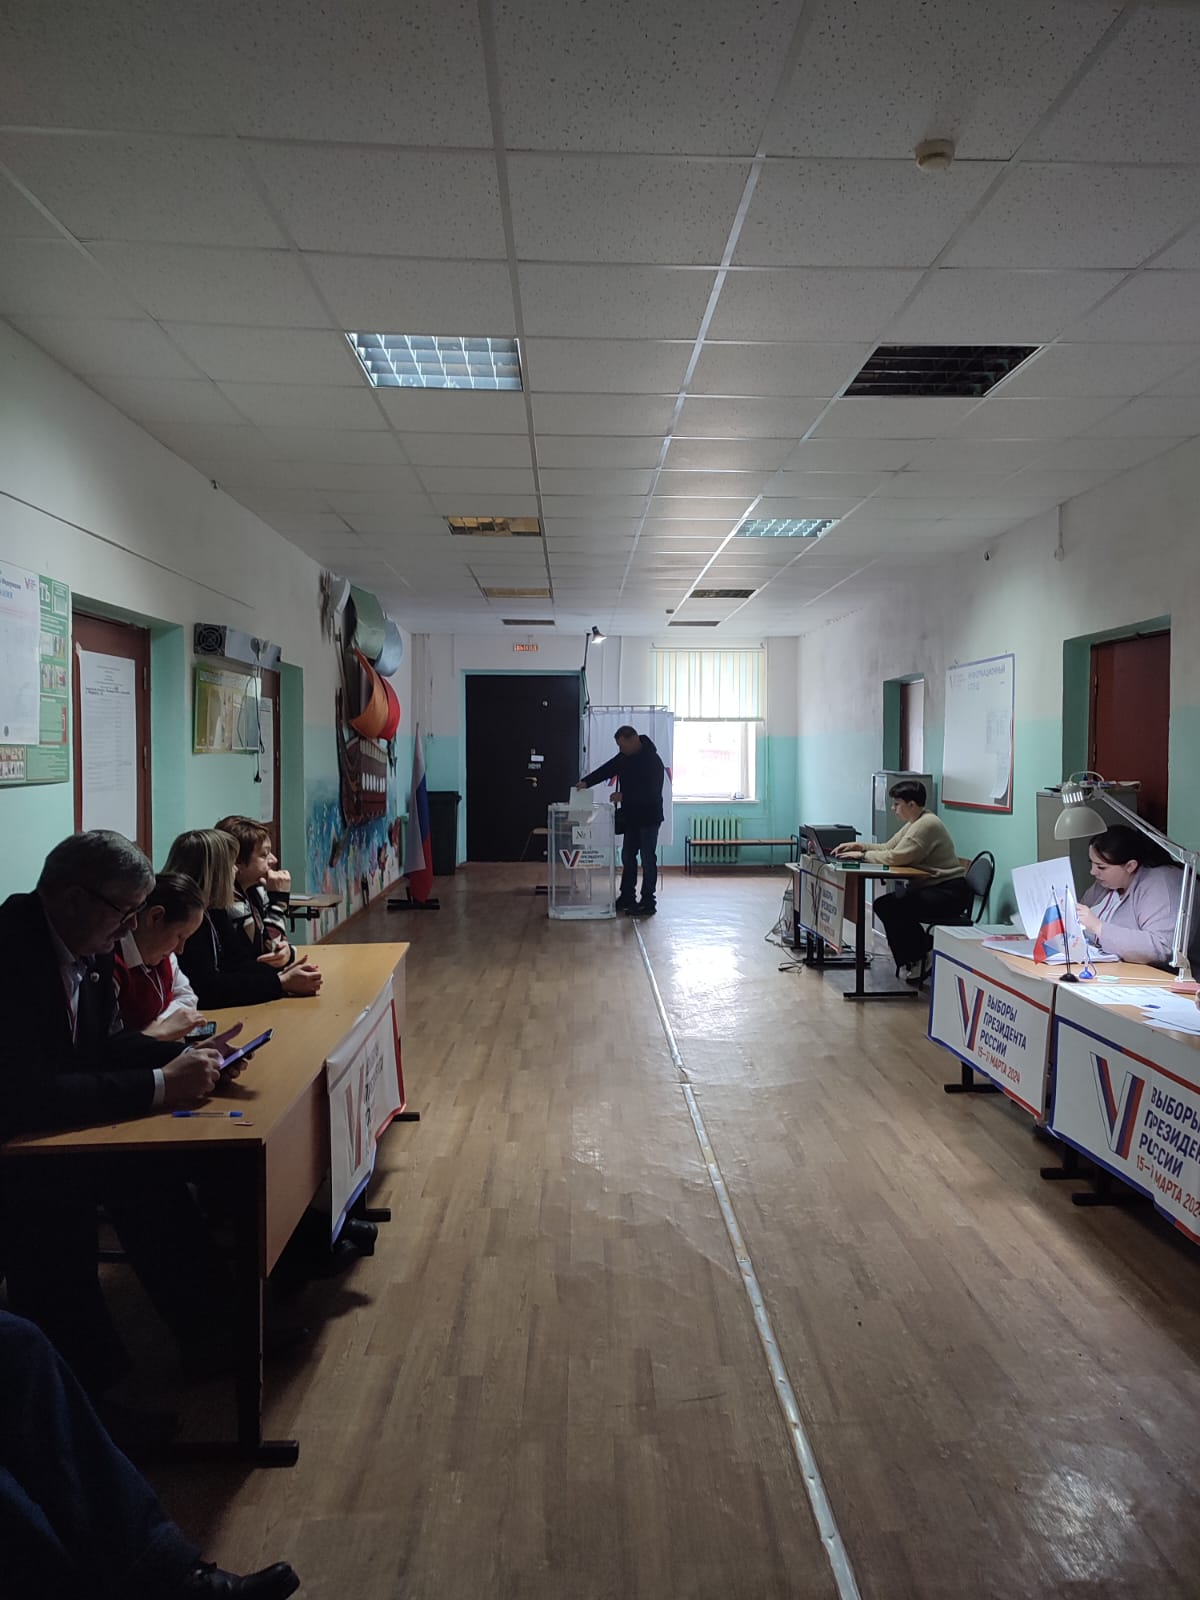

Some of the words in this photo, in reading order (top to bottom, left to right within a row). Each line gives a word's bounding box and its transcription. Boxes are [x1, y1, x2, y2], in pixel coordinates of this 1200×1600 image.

[986, 994, 1018, 1023] ВЫБОРЫ
[980, 1029, 1008, 1058] РОССИИ
[982, 1012, 1027, 1050] ПРЕЗИДЕНТА
[1153, 1170, 1183, 1204] МАРТА
[1182, 1193, 1200, 1218] 202
